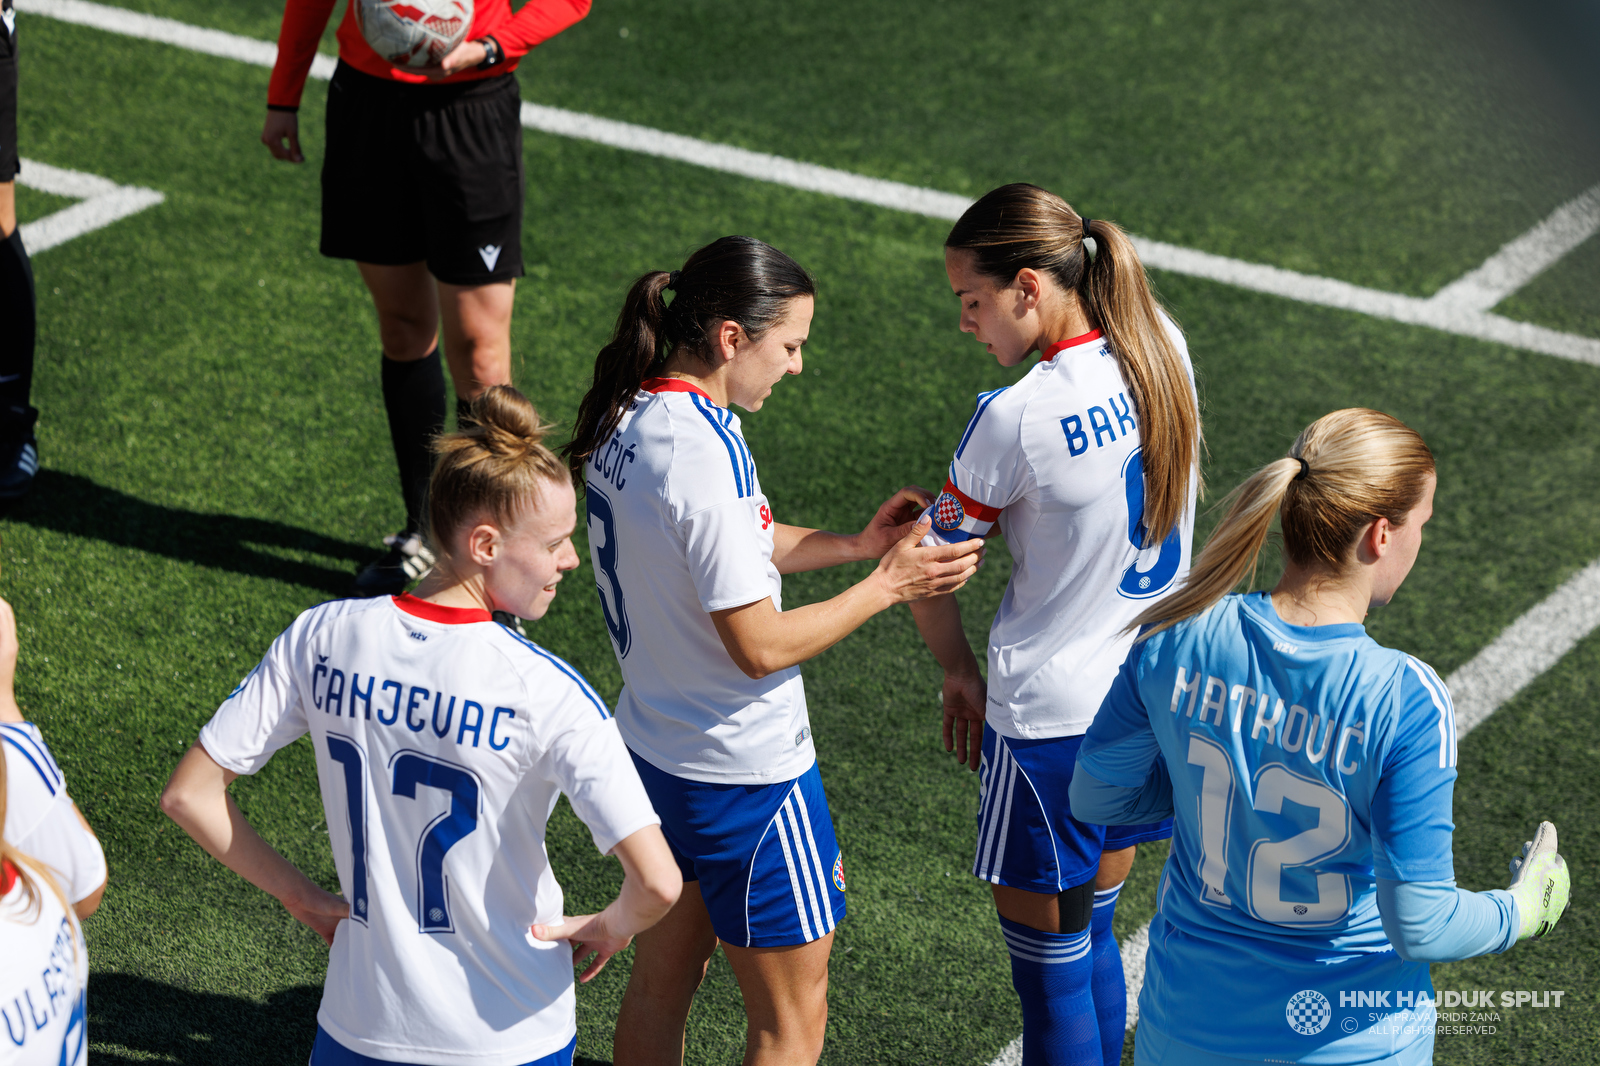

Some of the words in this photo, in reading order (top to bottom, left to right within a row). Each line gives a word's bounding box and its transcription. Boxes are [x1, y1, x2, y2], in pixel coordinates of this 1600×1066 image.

[1060, 388, 1140, 458] BAK
[586, 480, 632, 660] 3
[1273, 641, 1299, 655] HŽV
[313, 654, 516, 751] ČANJEVAC
[1170, 666, 1365, 775] MATKOVIĆ
[326, 730, 484, 934] 17
[1187, 732, 1353, 928] 12
[1543, 877, 1555, 908] PRED
